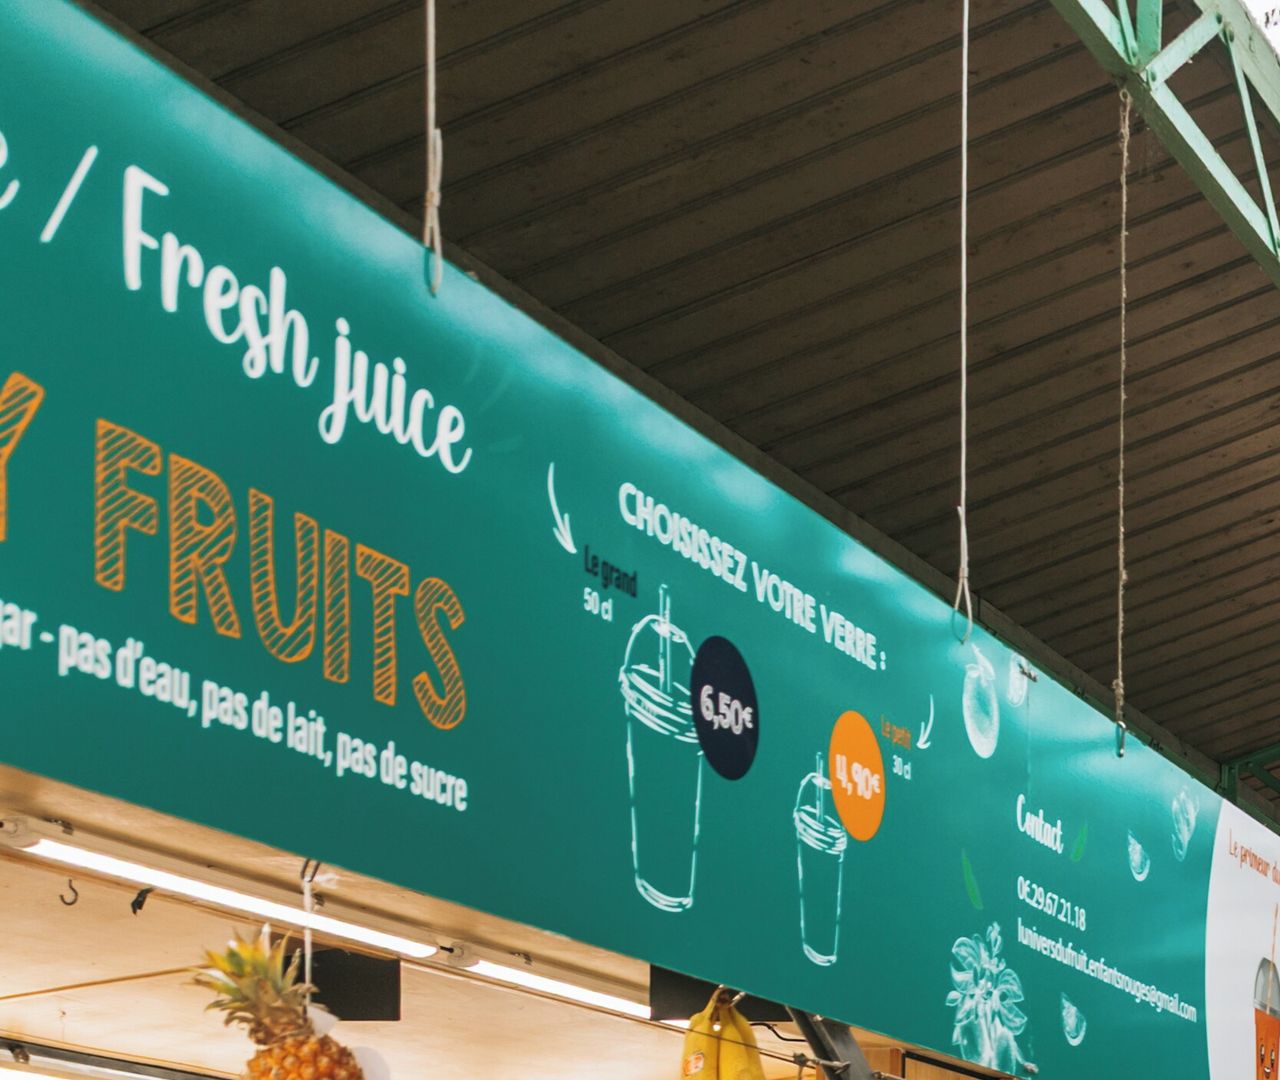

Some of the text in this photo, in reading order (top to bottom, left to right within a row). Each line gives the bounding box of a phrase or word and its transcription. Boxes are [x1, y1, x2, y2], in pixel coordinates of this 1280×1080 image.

[122, 164, 320, 389] Fresh
[318, 316, 473, 475] juice
[94, 417, 468, 730] FRUITS
[583, 544, 638, 598] Le grand
[618, 482, 748, 593] CHOISISSEZ
[751, 561, 817, 634] VOTRE
[819, 604, 877, 671] VERRE
[583, 587, 613, 622] 50 cl
[58, 624, 112, 679] pas
[115, 637, 198, 717] d'eau,
[202, 679, 249, 729] pas
[251, 690, 283, 744] de
[286, 701, 333, 768] lait,
[336, 731, 378, 777] pas
[379, 740, 408, 789] de
[409, 760, 468, 812] sucre
[700, 684, 754, 735] 6,50€
[835, 753, 881, 800] 4,90€
[1016, 793, 1064, 854] Contact
